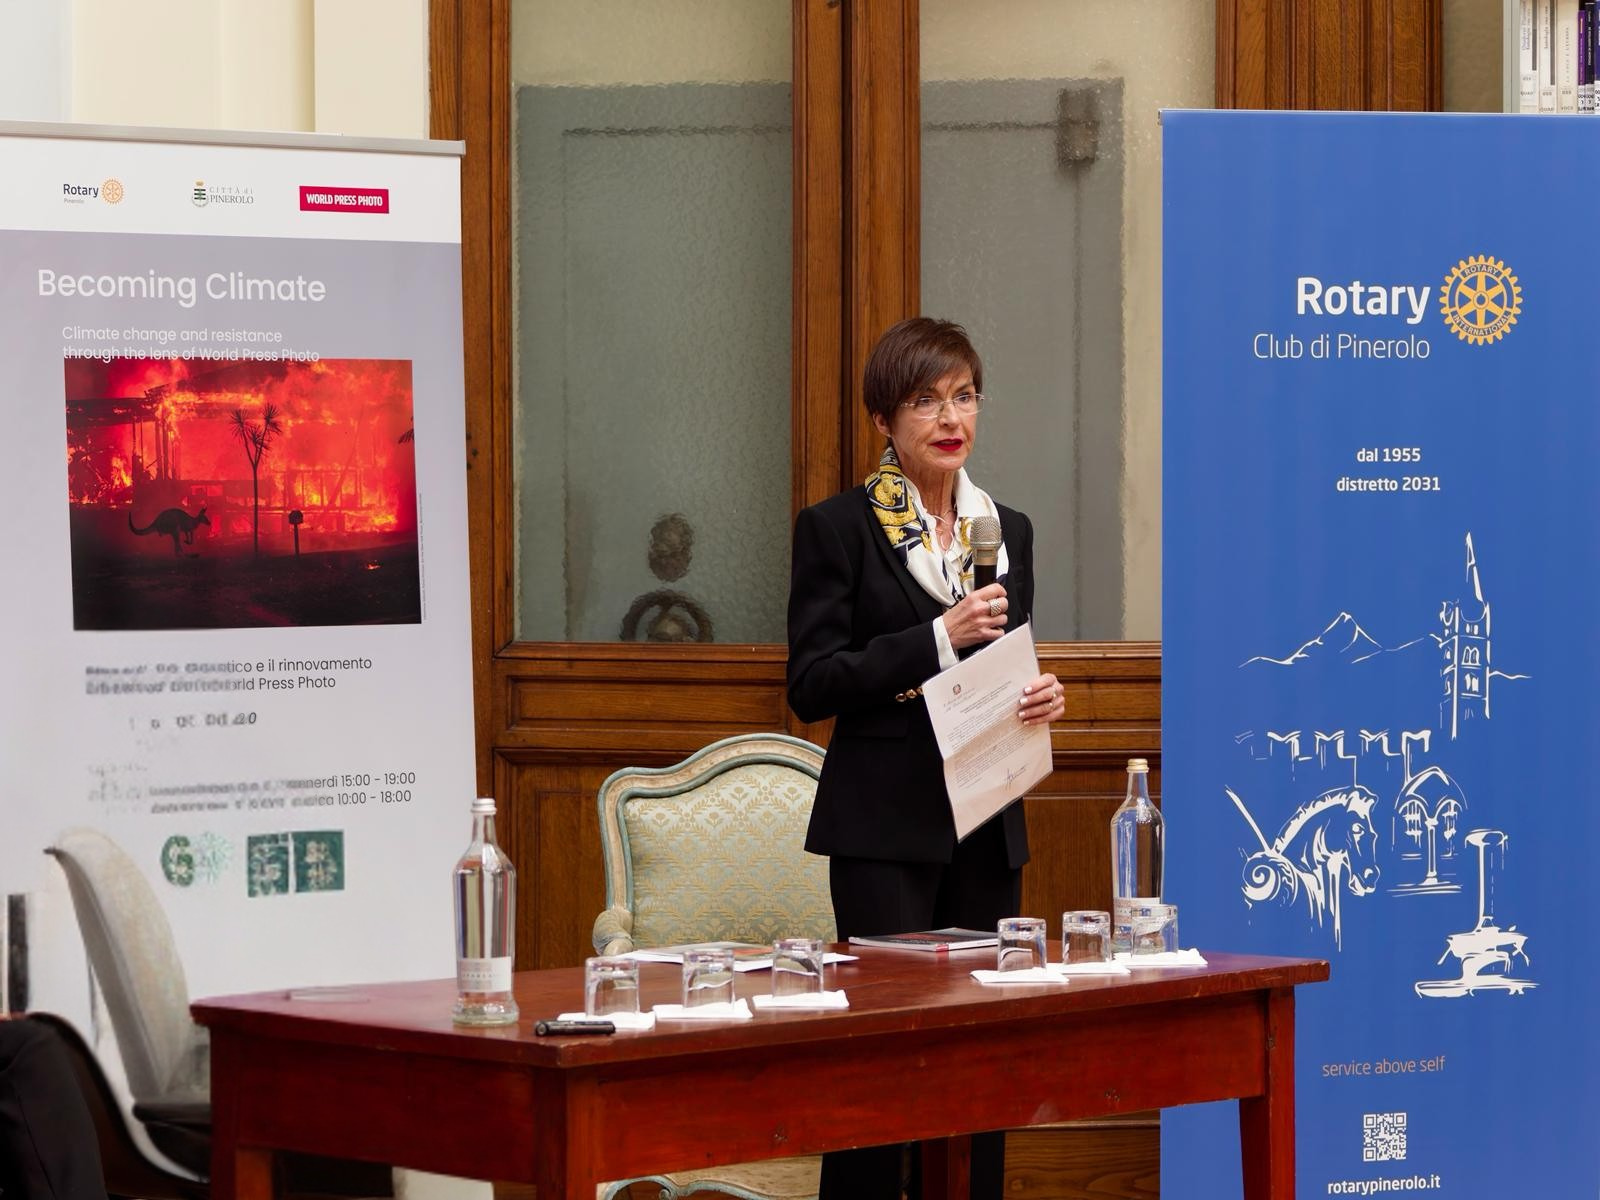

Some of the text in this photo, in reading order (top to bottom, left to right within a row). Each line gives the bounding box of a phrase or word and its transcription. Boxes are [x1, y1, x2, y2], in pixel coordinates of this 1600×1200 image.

[63, 183, 99, 198] Rotary
[209, 194, 254, 204] PINEROLO
[306, 193, 383, 207] WORLD PRESS PHOTO
[1464, 264, 1500, 276] ROTARY
[38, 269, 327, 308] Becoming Climate
[1297, 277, 1431, 324] Rotary
[1452, 313, 1510, 335] INTERNATIONAL
[62, 327, 283, 344] Climate change and resistance
[63, 346, 320, 363] through the lens of World Press Photo
[1254, 334, 1430, 359] Club di Pinerolo
[1356, 449, 1421, 463] dal 1955
[1336, 477, 1441, 492] distretto 2031
[256, 662, 265, 672] e
[268, 658, 275, 672] il
[278, 657, 372, 671] rinnovamento
[259, 677, 295, 690] Press
[298, 675, 337, 688] Photo
[341, 773, 371, 787] 15:00
[384, 771, 416, 785] 19:00
[337, 792, 367, 806] 10:00
[380, 790, 412, 804] 18:00
[1322, 1055, 1446, 1077] service above self
[1327, 1174, 1441, 1196] rotarypinerolo.it
